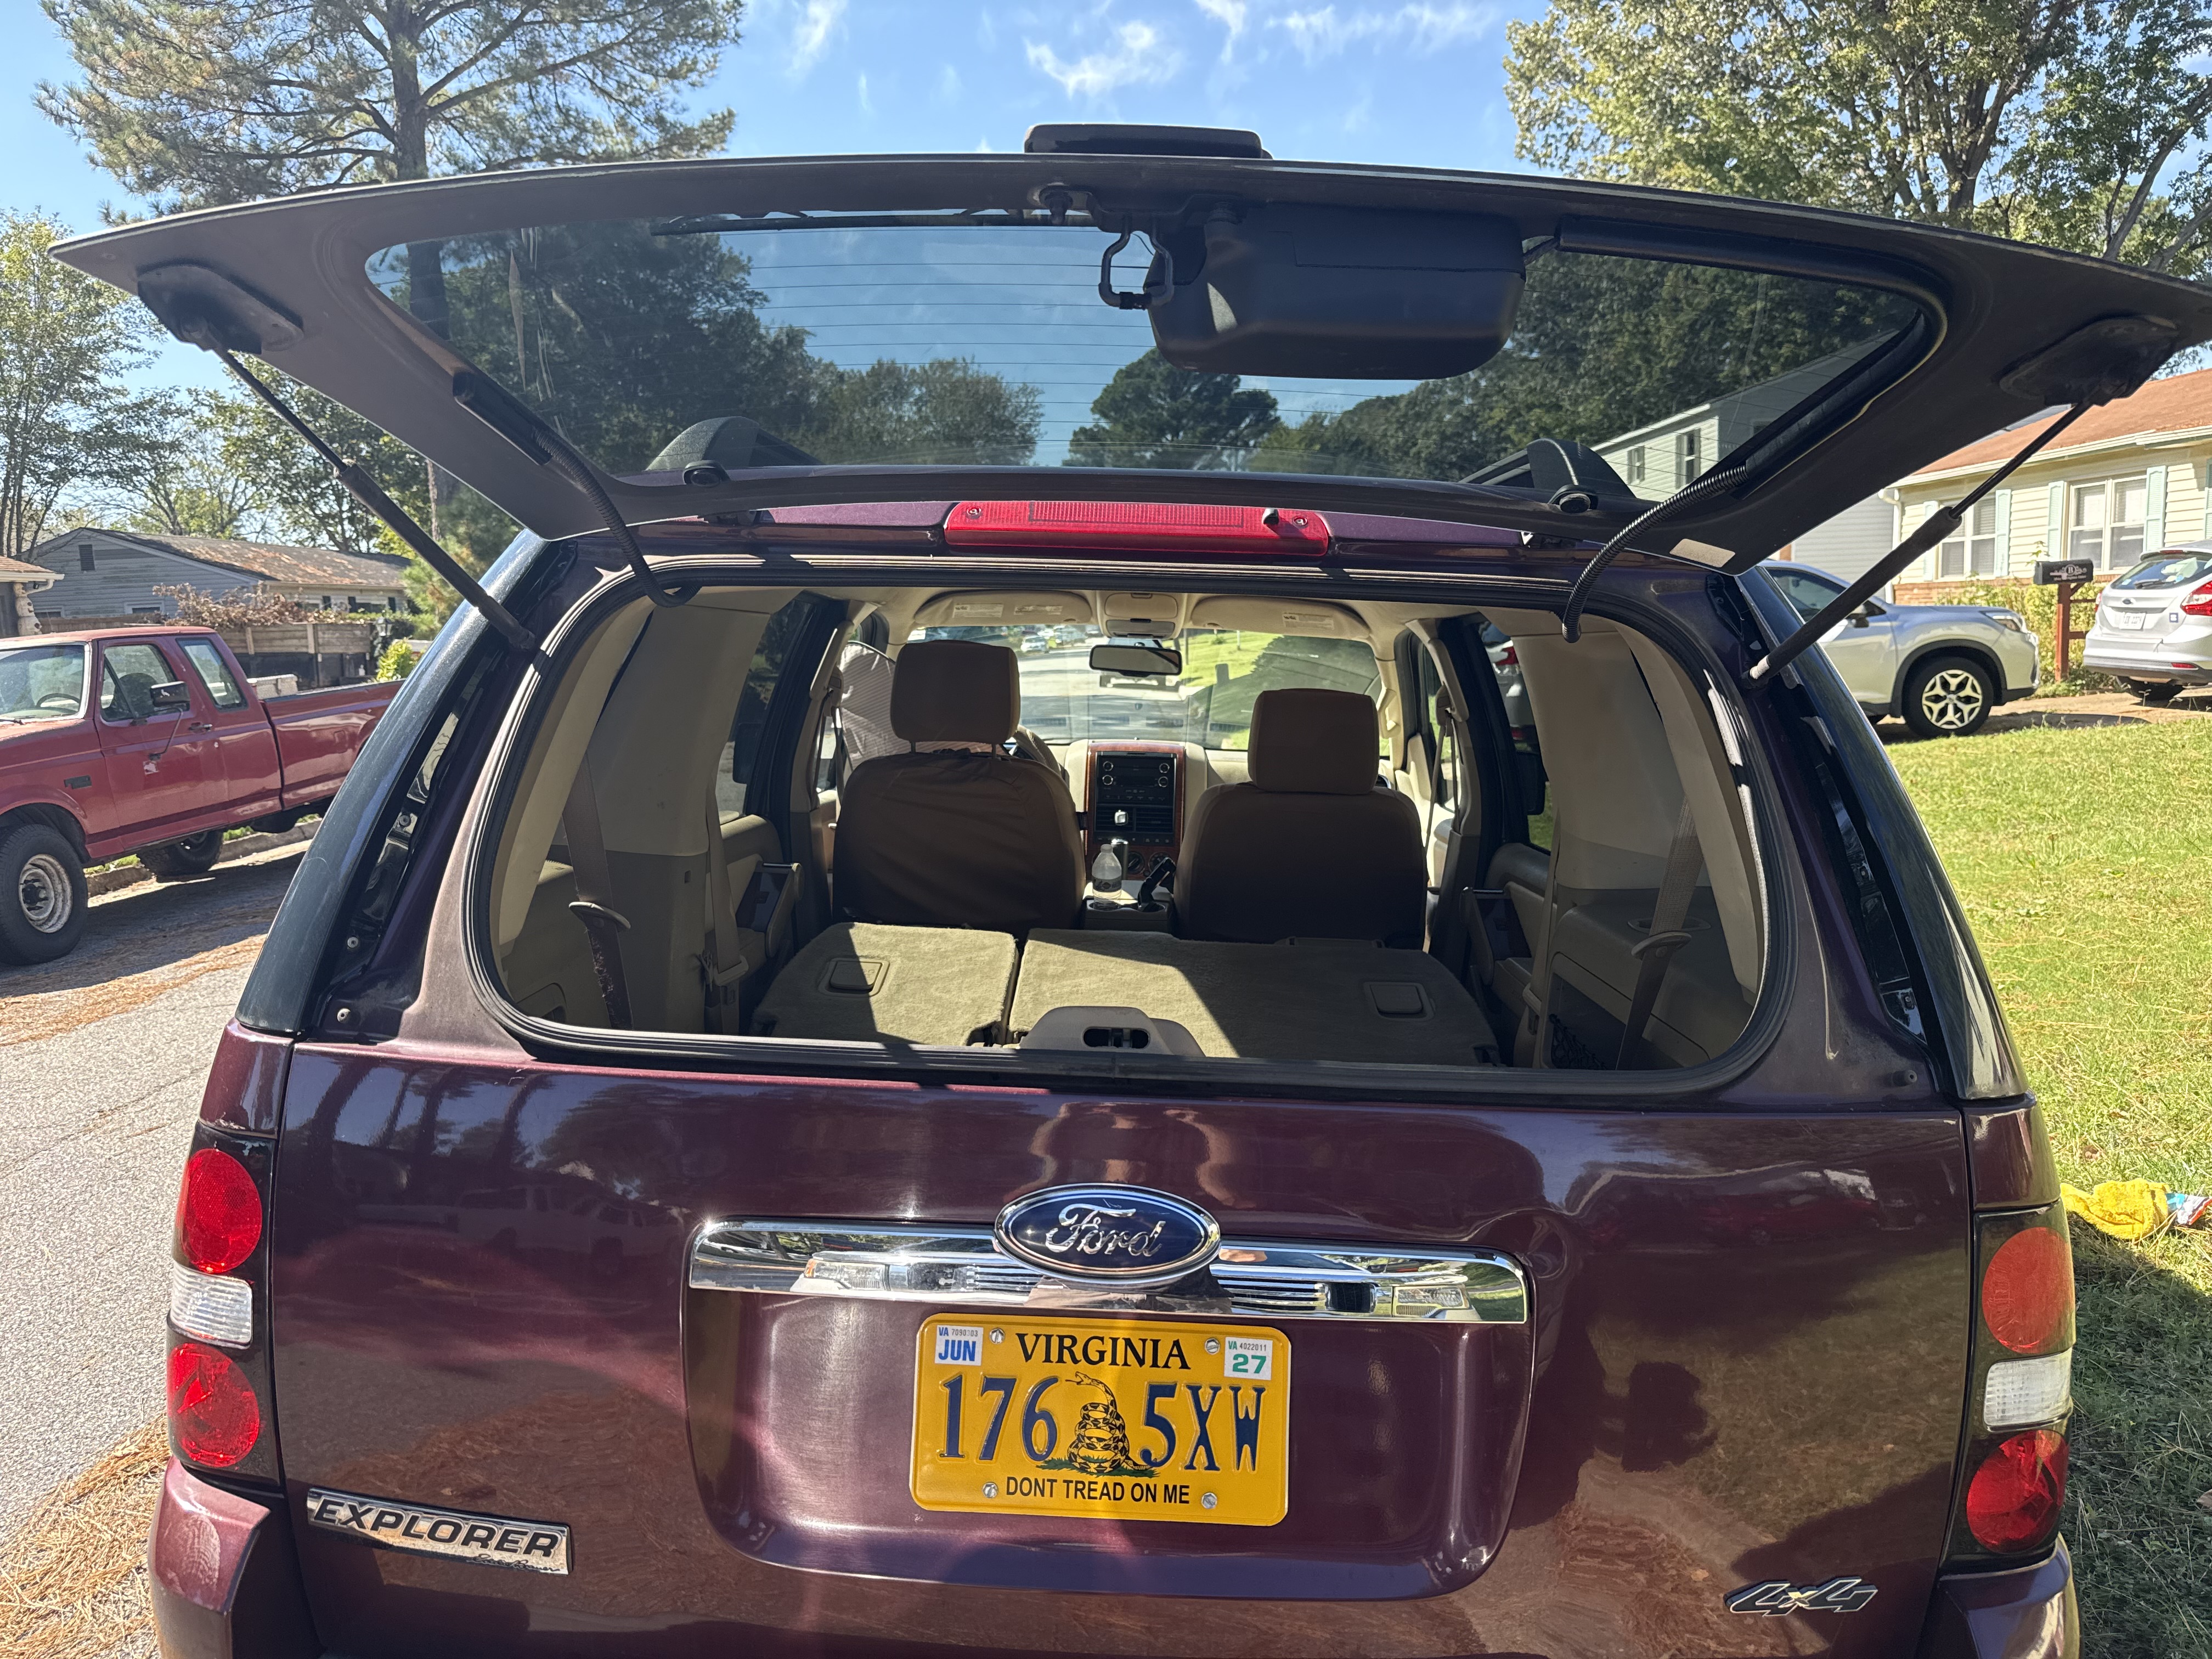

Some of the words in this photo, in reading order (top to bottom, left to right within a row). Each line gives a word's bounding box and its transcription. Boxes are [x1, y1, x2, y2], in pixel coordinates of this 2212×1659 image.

[1045, 1203, 1166, 1256] Ford
[939, 1327, 949, 1336] VA
[938, 1339, 977, 1362] JUN
[1015, 1333, 1191, 1370] VIRGINIA
[1228, 1340, 1238, 1350] VA
[1239, 1342, 1267, 1352] 4022011
[1232, 1353, 1267, 1374] 27
[938, 1374, 1060, 1461] 176
[1138, 1381, 1267, 1472] 5XW
[1006, 1476, 1058, 1499] DONT
[1063, 1479, 1125, 1502] TREAD
[1131, 1482, 1162, 1503] ON
[1164, 1483, 1190, 1504] ME
[313, 1498, 560, 1558] EXPLORER
